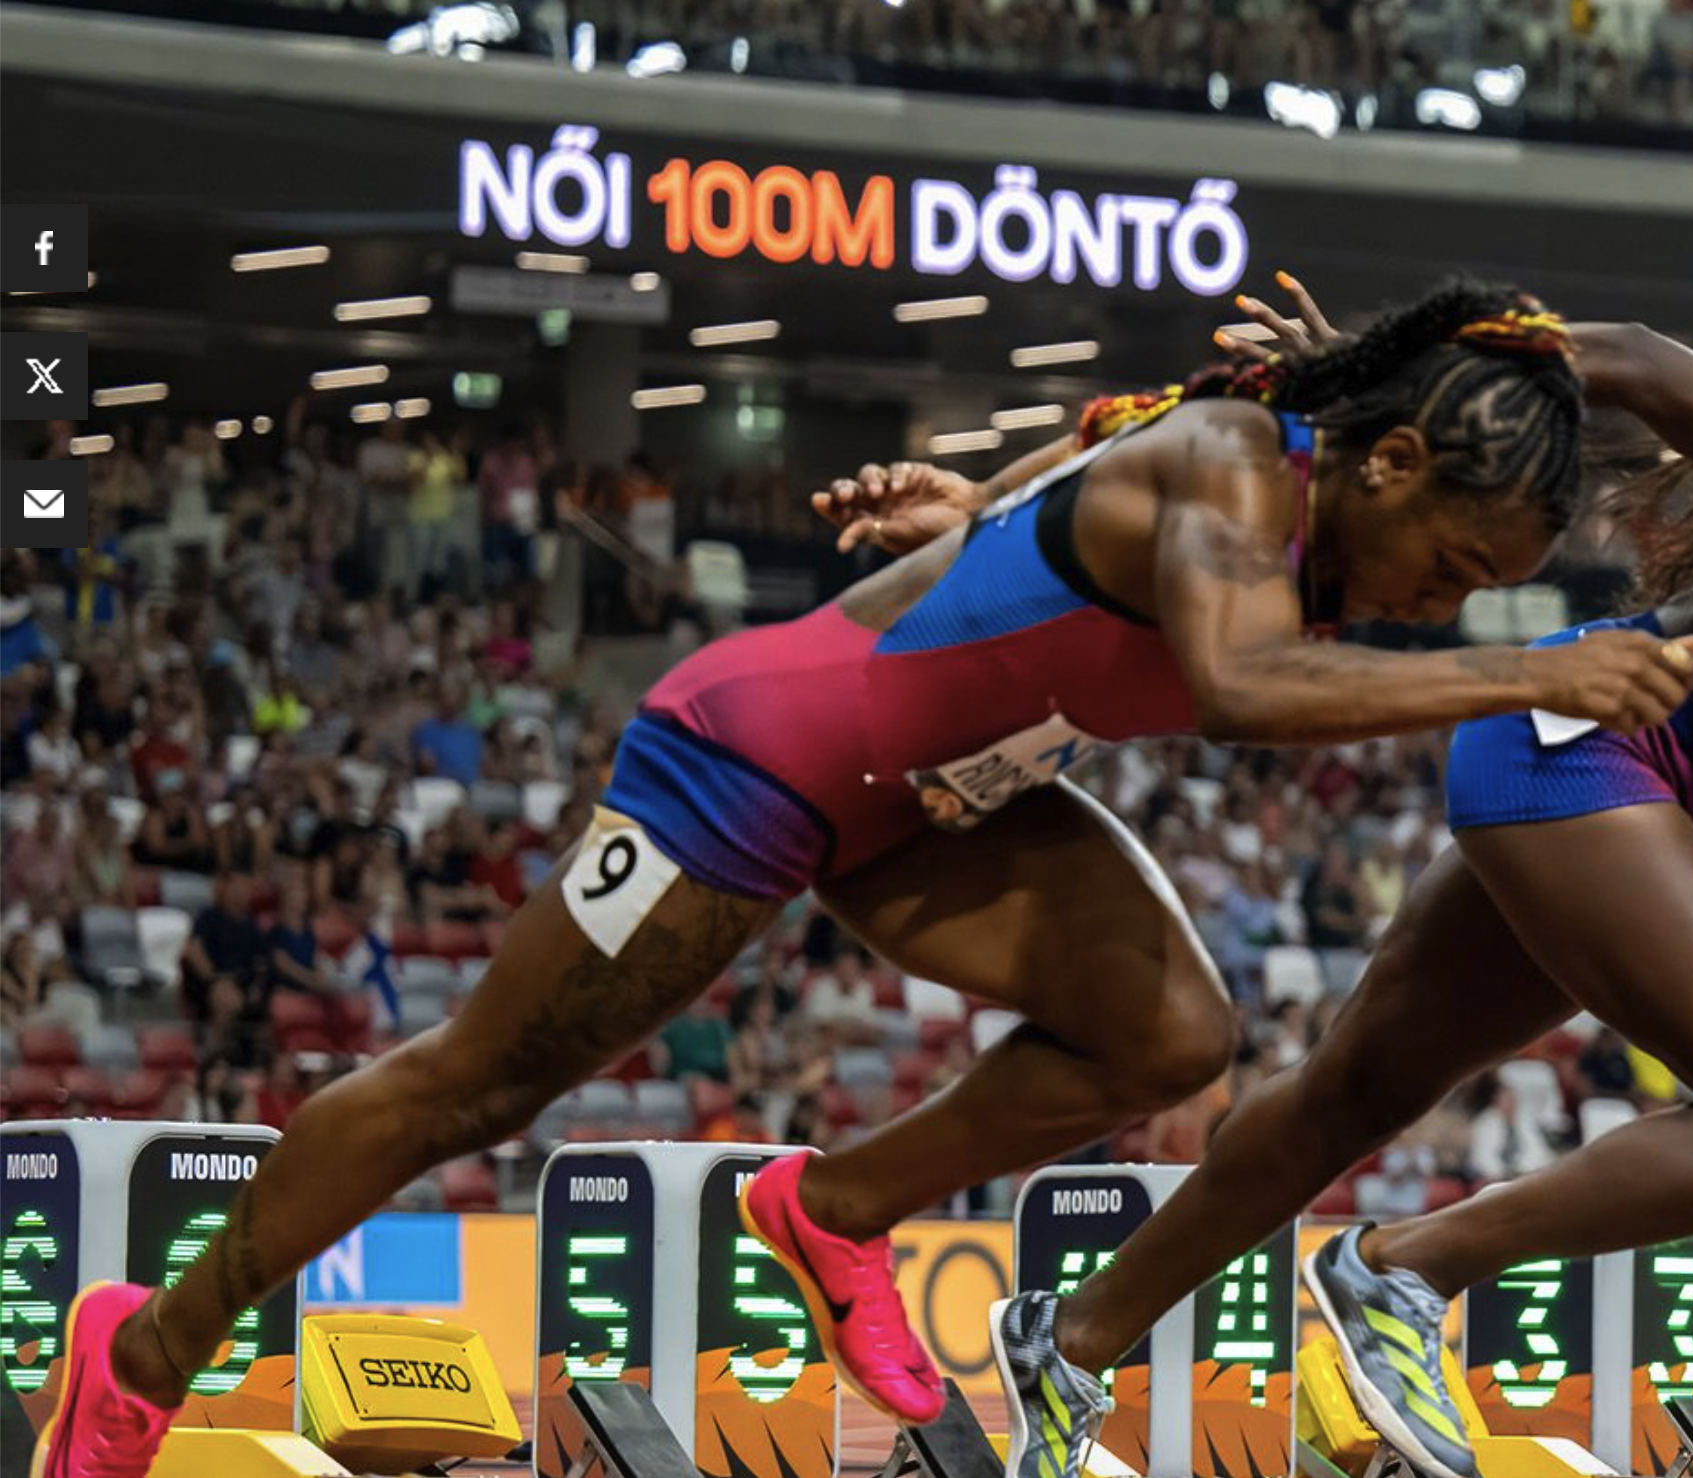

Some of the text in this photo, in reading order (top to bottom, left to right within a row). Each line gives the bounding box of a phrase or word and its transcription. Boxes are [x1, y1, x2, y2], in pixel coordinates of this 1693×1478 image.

[459, 124, 1249, 296] NŐI 100M DÖNTŐ
[582, 835, 637, 901] 9
[6, 1153, 58, 1179] MONDO
[171, 1152, 258, 1181] MONDO
[570, 1176, 628, 1202] MONDO
[1053, 1189, 1122, 1215] MONDO
[564, 1236, 628, 1379] 5
[729, 1236, 806, 1403] 5
[1213, 1254, 1276, 1407] 4
[1493, 1259, 1568, 1407] 3
[359, 1358, 471, 1394] SEIKO
